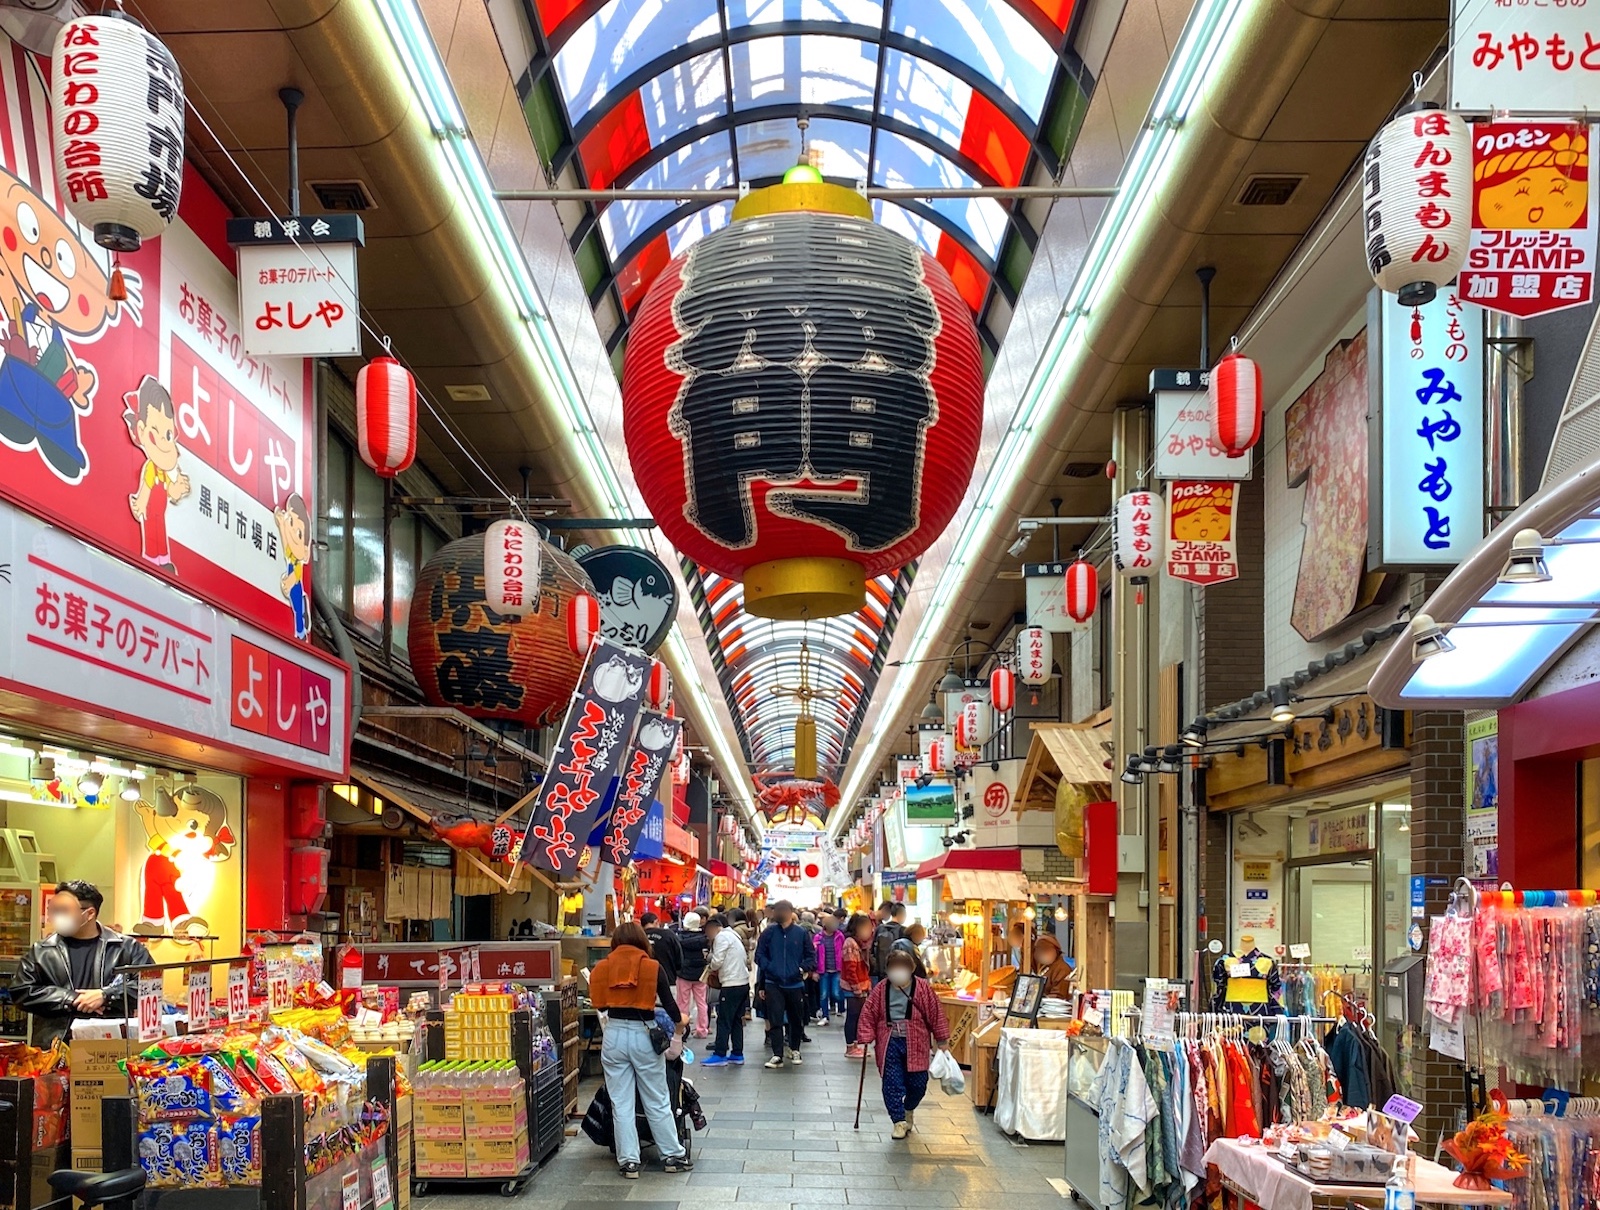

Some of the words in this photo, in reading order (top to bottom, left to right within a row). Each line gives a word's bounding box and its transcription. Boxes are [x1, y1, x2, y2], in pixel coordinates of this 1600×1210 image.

[1472, 31, 1600, 71] みやもと
[64, 23, 108, 203] なにわの台所
[1476, 129, 1551, 156] クロモン
[1411, 113, 1452, 263] ほんまもん
[1480, 231, 1573, 248] フレッシュ
[1469, 249, 1585, 269] STAMP
[258, 266, 335, 285] お菓子のデパート
[1468, 274, 1584, 299] 加盟店
[255, 300, 344, 331] よしや
[179, 365, 291, 505] よしや
[1415, 367, 1462, 550] みやもと
[1173, 483, 1214, 498] クロモン
[199, 484, 277, 562] 黒門市場店
[1132, 493, 1152, 568] ほんまもん
[1172, 551, 1231, 562] STAMP
[1176, 541, 1224, 550] フレッシュ
[503, 525, 523, 605] なにわの台所
[1173, 564, 1233, 576] 加盟店
[35, 582, 210, 685] お菓子のデパート
[601, 620, 648, 644] っちり
[1029, 629, 1043, 680] ほんまもん
[237, 655, 328, 742] よしや
[492, 828, 510, 855] 浜藤
[614, 868, 651, 878] Shi
[497, 962, 526, 976] 浜藤
[191, 988, 205, 1021] 109
[230, 984, 244, 1014] 155
[273, 979, 287, 1008] 159
[141, 995, 158, 1031] 109
